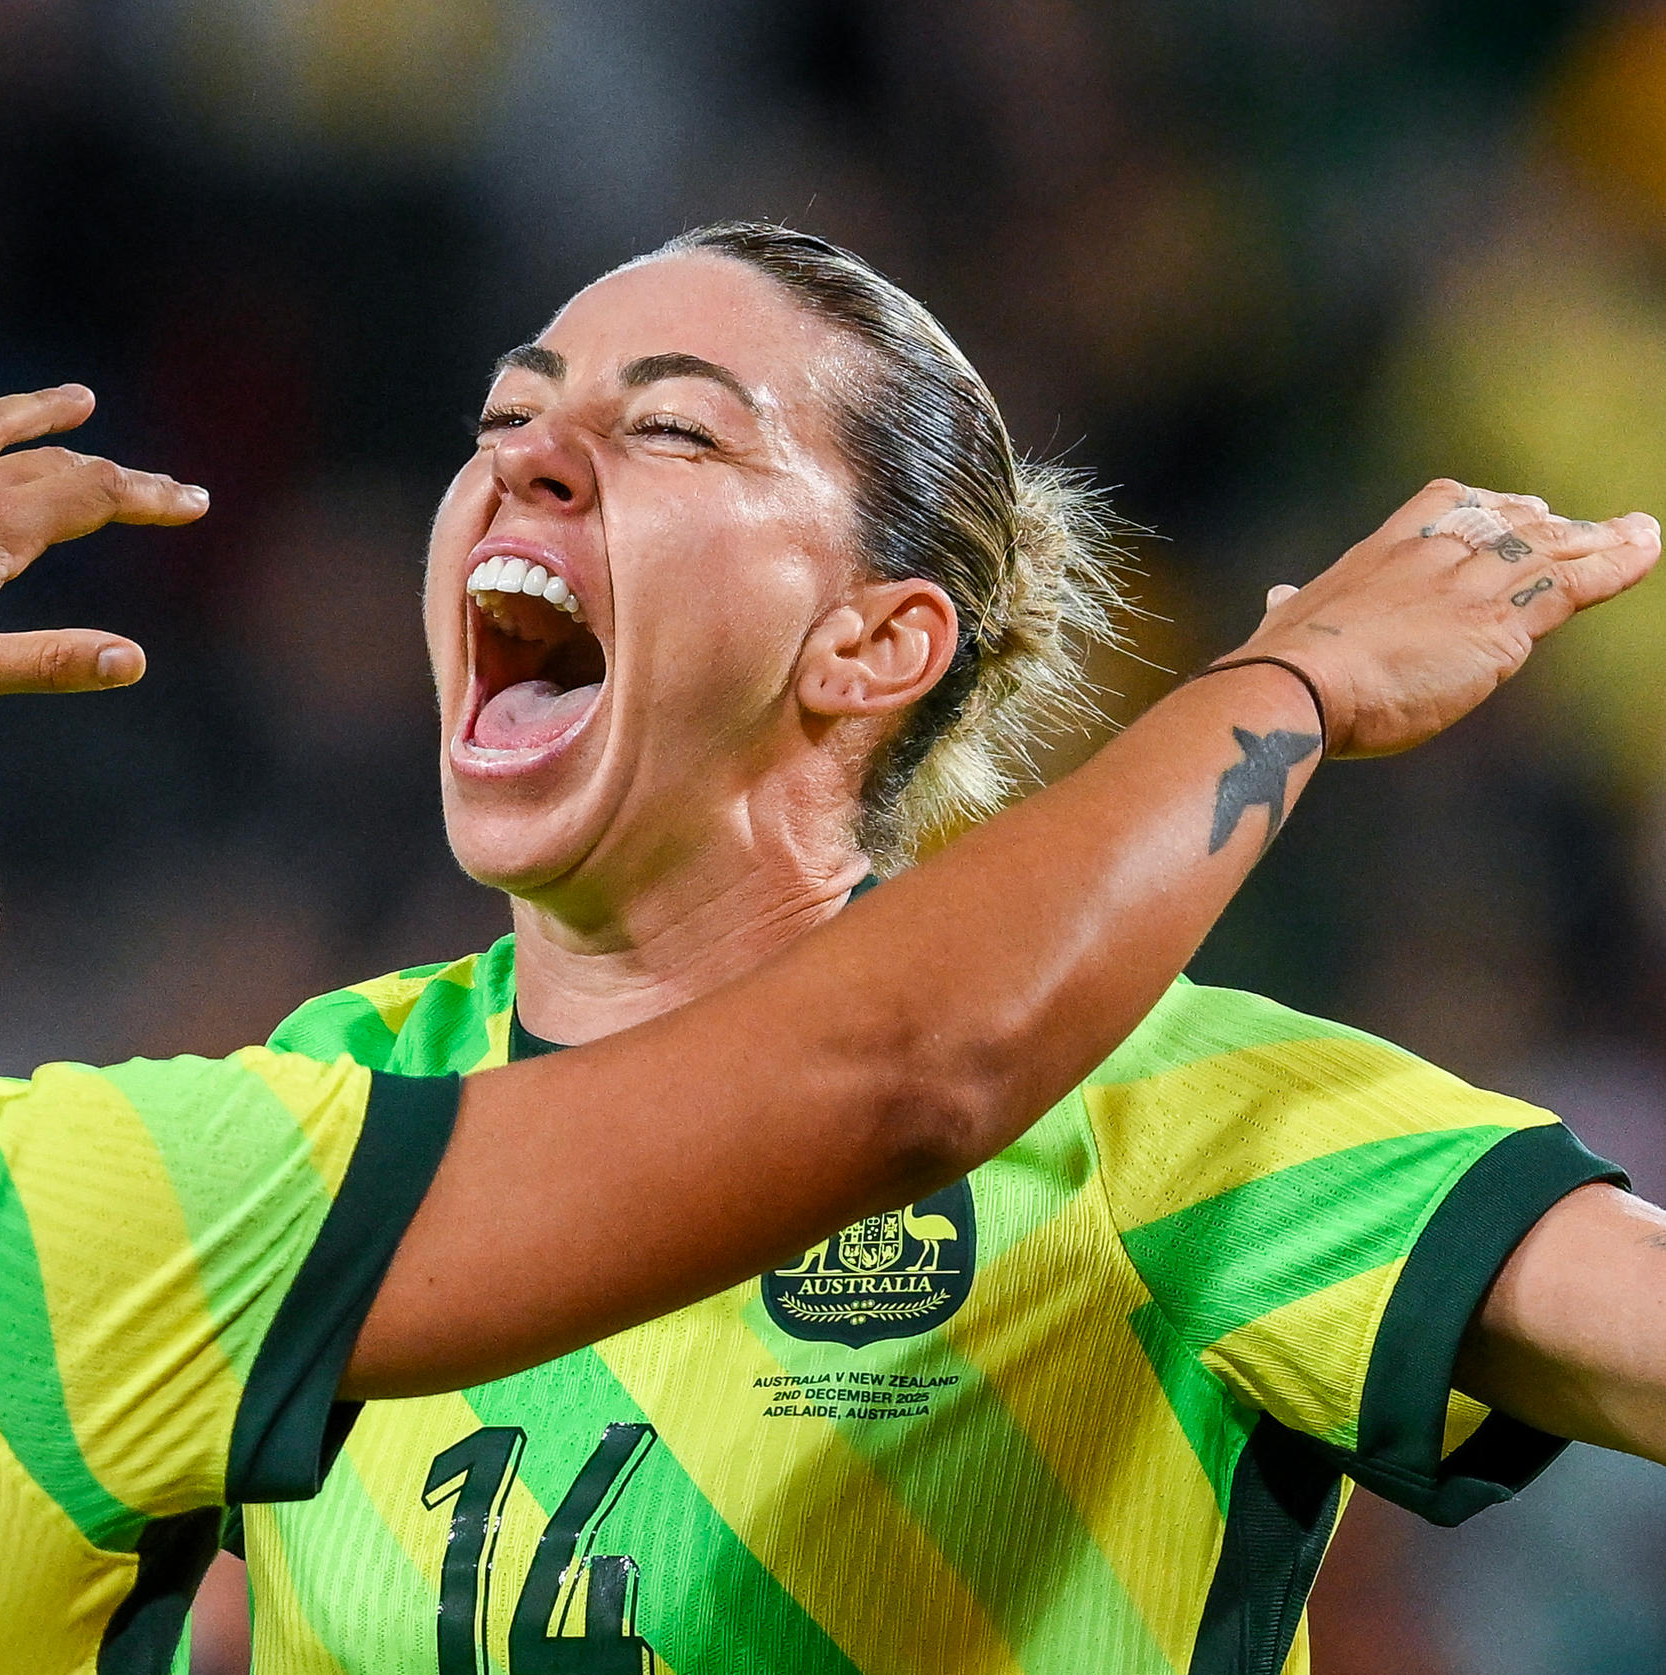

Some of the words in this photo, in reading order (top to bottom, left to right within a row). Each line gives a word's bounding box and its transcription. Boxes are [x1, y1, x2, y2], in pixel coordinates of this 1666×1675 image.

[797, 1275, 933, 1295] AUSTRALIA
[753, 1373, 831, 1388] AUSTRALIA
[835, 1372, 845, 1383] V
[848, 1372, 885, 1386] NEW
[888, 1374, 960, 1388] ZEALAND
[773, 1390, 801, 1401] 2ND
[804, 1388, 892, 1404] DECEMBER
[895, 1392, 930, 1404] 2025
[763, 1405, 841, 1420] ADELAIDE,
[846, 1405, 930, 1420] AUSTRALIA
